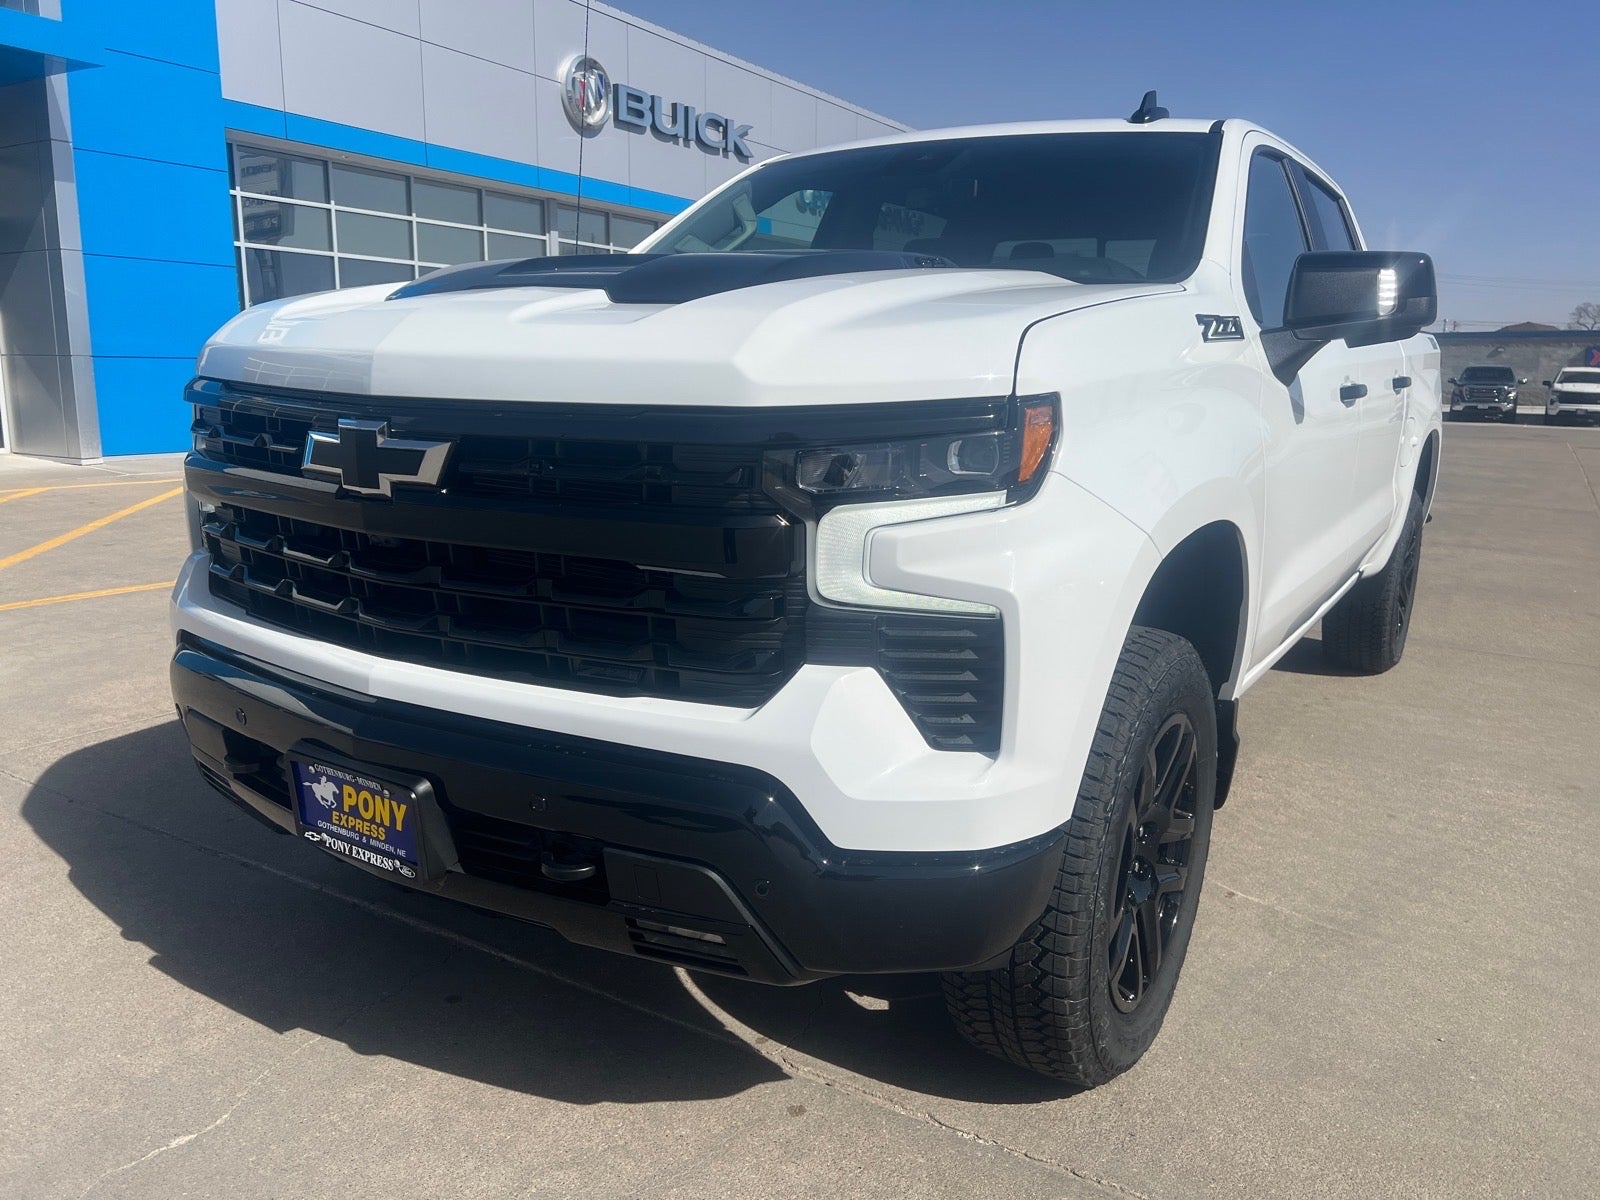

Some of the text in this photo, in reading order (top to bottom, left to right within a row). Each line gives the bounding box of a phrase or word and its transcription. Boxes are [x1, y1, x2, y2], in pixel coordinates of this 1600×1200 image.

[613, 83, 753, 160] BUICK
[332, 811, 386, 841] EXPRESS
[342, 784, 407, 832] PONY
[317, 820, 360, 841] GOTHENBURG
[396, 848, 407, 858] NE
[325, 835, 394, 872] PONY EXPRESS
